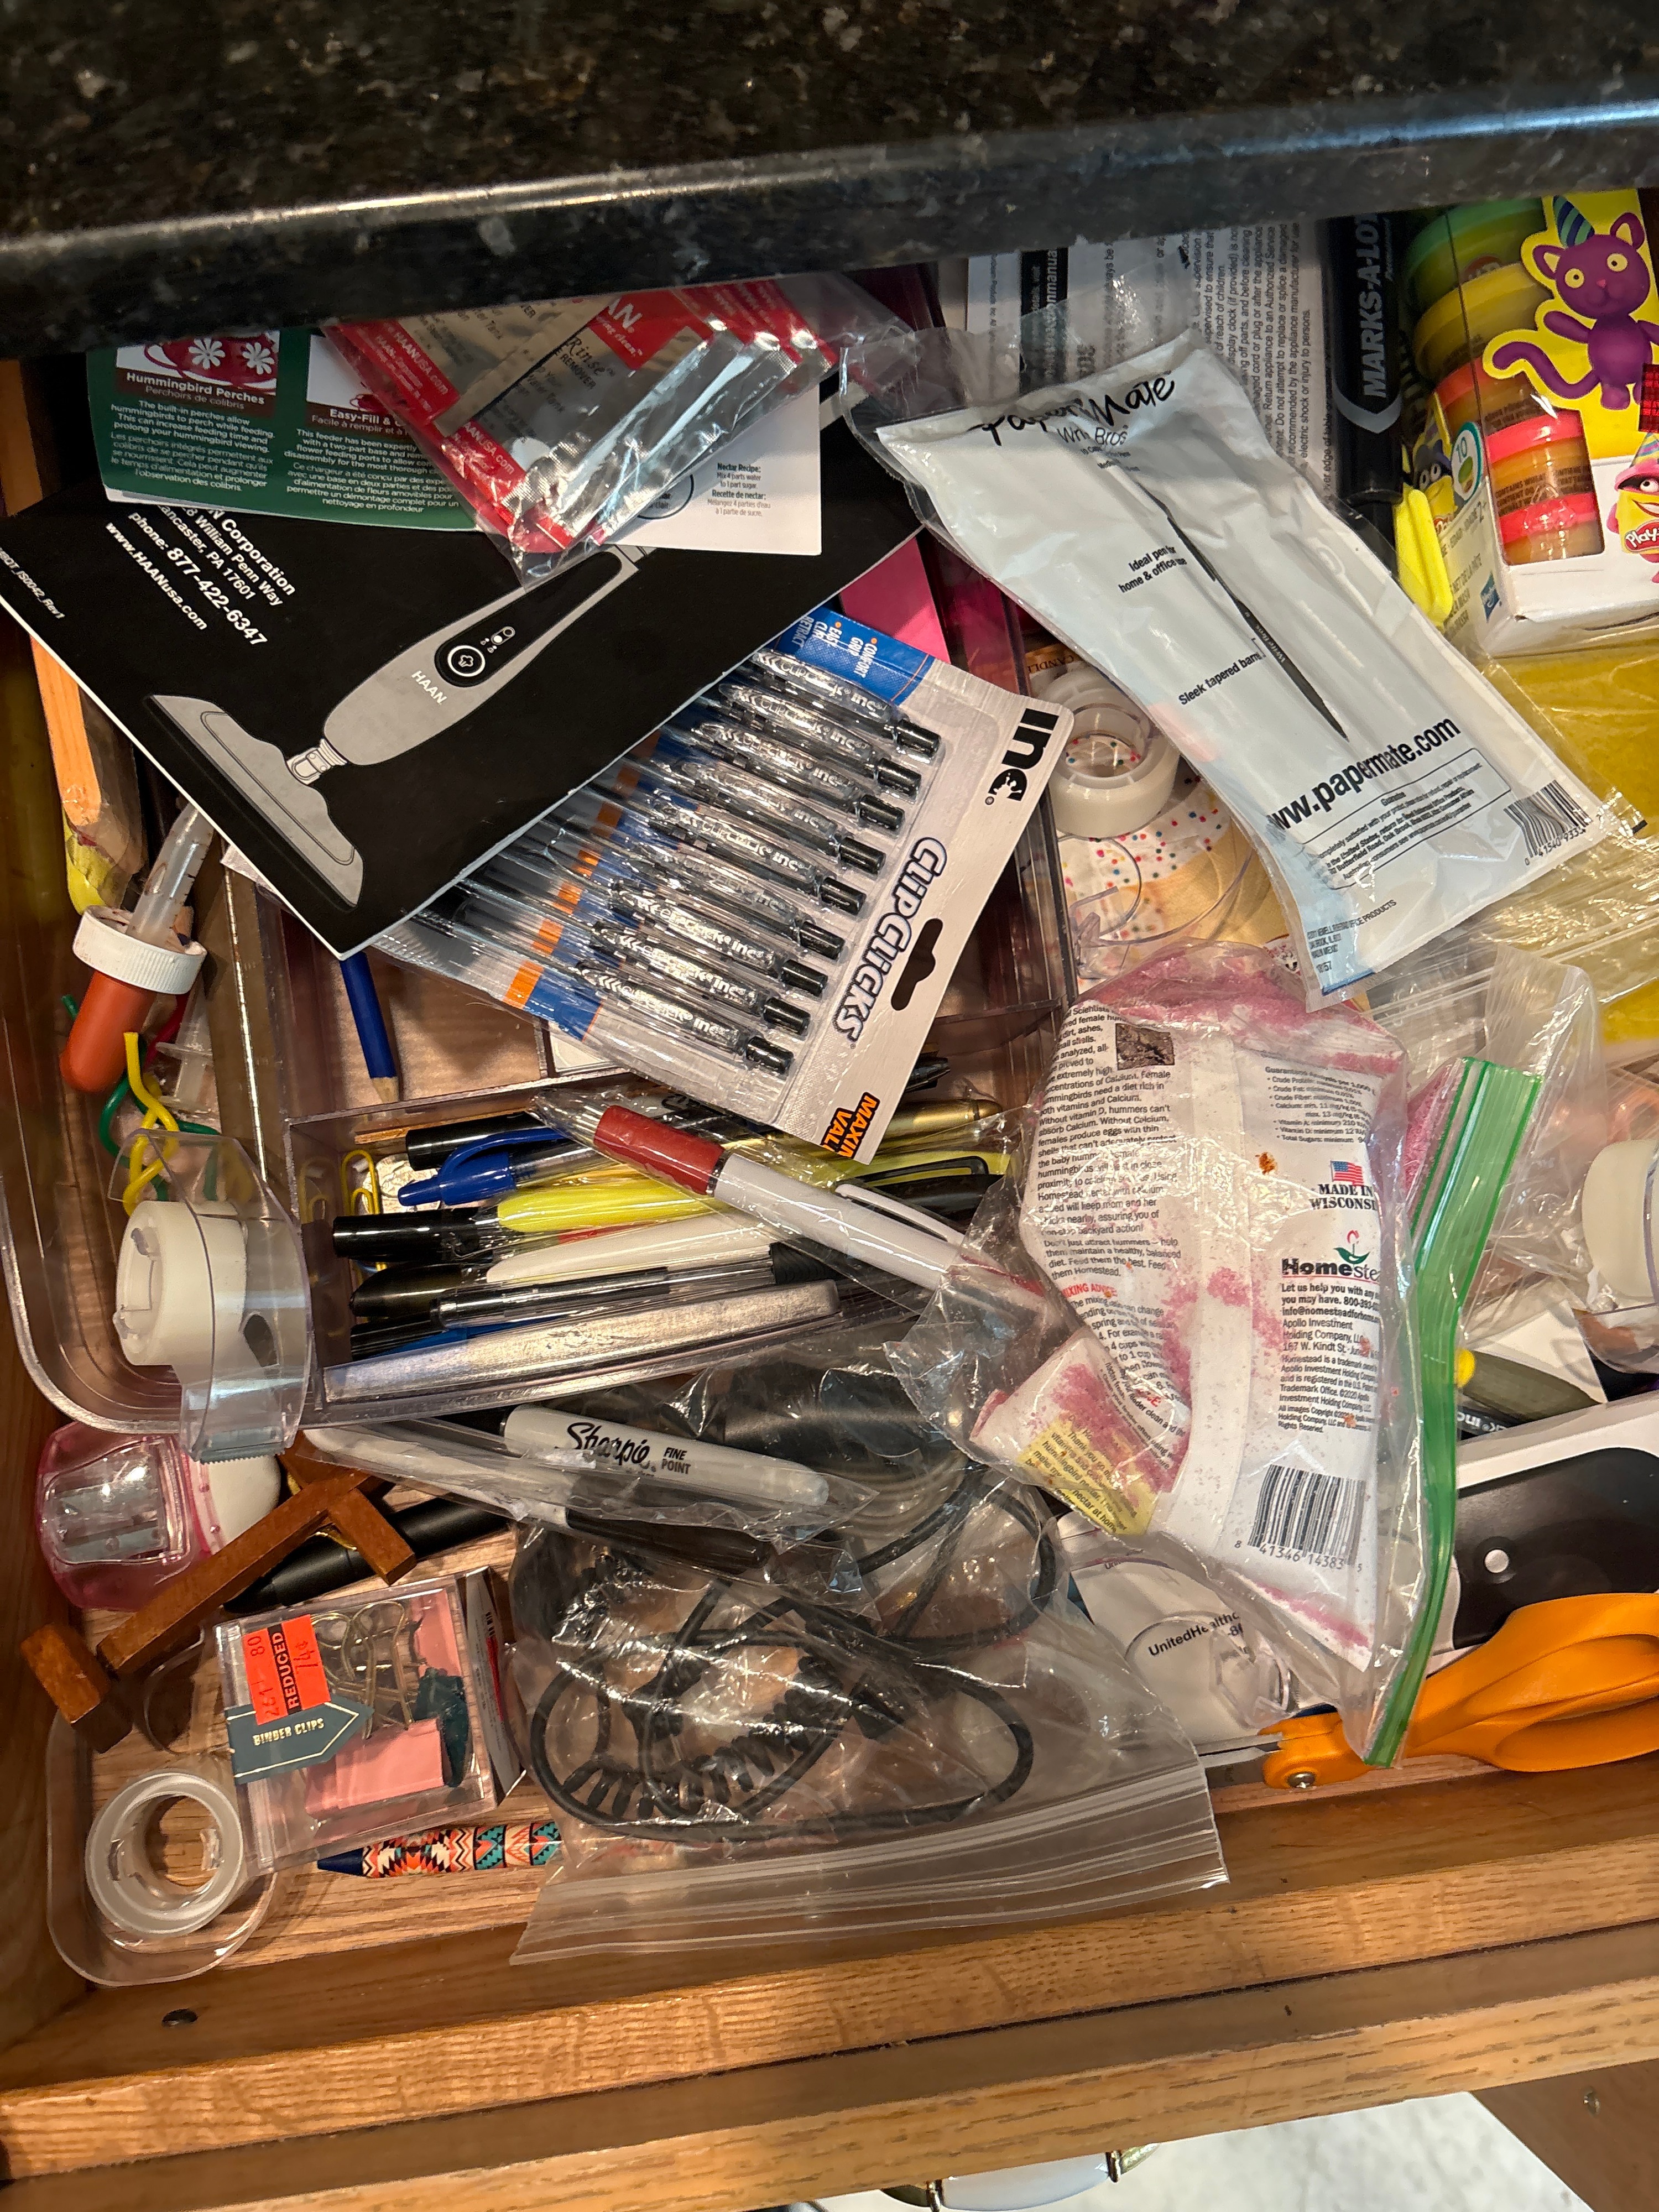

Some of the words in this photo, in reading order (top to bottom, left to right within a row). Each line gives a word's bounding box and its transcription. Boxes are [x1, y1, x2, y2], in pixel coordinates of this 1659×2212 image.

[1217, 302, 1224, 312] of
[1216, 315, 1224, 340] reach
[1301, 309, 1311, 346] persons.
[1276, 362, 1286, 393] attempt
[1288, 361, 1297, 374] the
[1301, 360, 1311, 383] injury
[127, 372, 212, 395] Hummingbird
[216, 388, 265, 405] Perches
[1288, 378, 1298, 388] by
[1302, 386, 1309, 395] or
[145, 385, 191, 400] Perchoirs
[195, 394, 207, 403] de
[210, 395, 244, 409] colibris
[1263, 380, 1272, 410] Return
[1276, 396, 1285, 410] not
[138, 400, 155, 410] The
[190, 409, 225, 421] perches
[226, 414, 250, 426] allow
[330, 409, 379, 425] Easy-Fill
[1275, 413, 1284, 426] Do
[1300, 398, 1310, 423] shock
[111, 404, 175, 421] hummingbirds
[177, 414, 186, 422] to
[189, 417, 214, 429] perch
[216, 420, 239, 432] while
[241, 425, 275, 439] feeding.
[118, 413, 136, 422] This
[156, 420, 192, 431] increase
[195, 426, 227, 439] feeding
[229, 431, 249, 442] time
[251, 435, 268, 445] and
[312, 415, 339, 426] Facile
[349, 422, 383, 433] remplir
[114, 421, 149, 434] prolong
[152, 427, 173, 437] your
[174, 430, 232, 447] hummingbird
[234, 440, 270, 453] viewing.
[296, 428, 314, 439] This
[316, 432, 343, 443] feeder
[345, 437, 359, 445] has
[361, 439, 382, 448] been
[384, 443, 418, 453] expertly
[1298, 426, 1309, 458] electric
[330, 442, 366, 453] two-part
[368, 447, 388, 456] base
[717, 462, 737, 471] Nectar
[738, 464, 761, 473] Recipe:
[286, 486, 329, 497] permettre
[712, 489, 734, 498] Recette
[322, 498, 364, 509] nettoyage
[378, 504, 424, 513] profondeur
[1625, 528, 1659, 549] Play-
[157, 504, 207, 553] ancaster,
[206, 551, 225, 569] PA
[222, 568, 255, 599] 17601
[195, 515, 233, 555] William
[231, 554, 260, 583] Penn
[258, 581, 283, 606] Way
[222, 519, 295, 596] Corporation
[1128, 553, 1152, 571] Ideal
[106, 522, 207, 630] www.HAANusa.com
[128, 513, 169, 550] phone:
[167, 547, 268, 645] 877-422-6347
[1118, 576, 1144, 593] home
[1143, 571, 1153, 581] &
[1152, 559, 1177, 576] office
[848, 637, 864, 656] GRIP
[853, 643, 878, 678] COMFORT
[411, 670, 447, 705] HAAN
[1178, 684, 1207, 705] Sleek
[1204, 662, 1240, 688] tapered
[1267, 718, 1462, 831] ww.papermate.com
[1362, 900, 1397, 922] PRODUCTS
[1078, 1014, 1105, 1024] female
[1078, 1025, 1103, 1035] ashes,
[1061, 1046, 1095, 1058] analyzed,
[1057, 1068, 1094, 1081] extremely
[1095, 1066, 1113, 1076] high
[1057, 1100, 1089, 1112] vitamins
[1091, 1097, 1105, 1107] and
[1107, 1094, 1142, 1103] Calcium.
[1040, 1115, 1068, 1126] Without
[1070, 1109, 1097, 1121] vitamin
[1109, 1105, 1147, 1114] hummers
[1149, 1104, 1171, 1113] can't
[822, 1110, 852, 1152] VAL
[1039, 1126, 1064, 1137] absorb
[1066, 1121, 1098, 1131] Calcium.
[1099, 1117, 1131, 1125] Without
[1038, 1135, 1068, 1147] females
[1070, 1129, 1100, 1141] produce
[1103, 1128, 1121, 1136] eggs
[1318, 1184, 1358, 1196] MADE
[1361, 1186, 1374, 1197] IN
[1309, 1197, 1378, 1211] WISCONSI
[1281, 1258, 1381, 1281] Homeste
[1281, 1283, 1295, 1292] Let
[1310, 1283, 1328, 1293] help
[1331, 1285, 1345, 1295] you
[1348, 1286, 1363, 1296] with
[1318, 1295, 1342, 1304] have.
[1092, 1318, 1117, 1330] spring
[1283, 1319, 1307, 1328] Apollo
[1308, 1318, 1353, 1329] Investment
[1314, 1329, 1352, 1343] Company,
[1300, 1342, 1311, 1350] W.
[1313, 1342, 1335, 1352] Kindt
[1280, 1384, 1319, 1393] Trademark
[664, 1447, 687, 1460] FINE
[661, 1458, 692, 1475] POINT
[1073, 1489, 1094, 1510] nectar
[1100, 1515, 1117, 1533] home
[1234, 1540, 1242, 1548] 8
[1260, 1544, 1301, 1562] 41346
[1308, 1553, 1344, 1569] 14383
[1357, 1563, 1363, 1572] 5
[1148, 1611, 1239, 1656] UnitedHealthc
[247, 1636, 265, 1656] 80
[272, 1632, 299, 1709] REDUCED
[253, 1726, 292, 1746] BINDER
[294, 1718, 324, 1735] CLIPS
